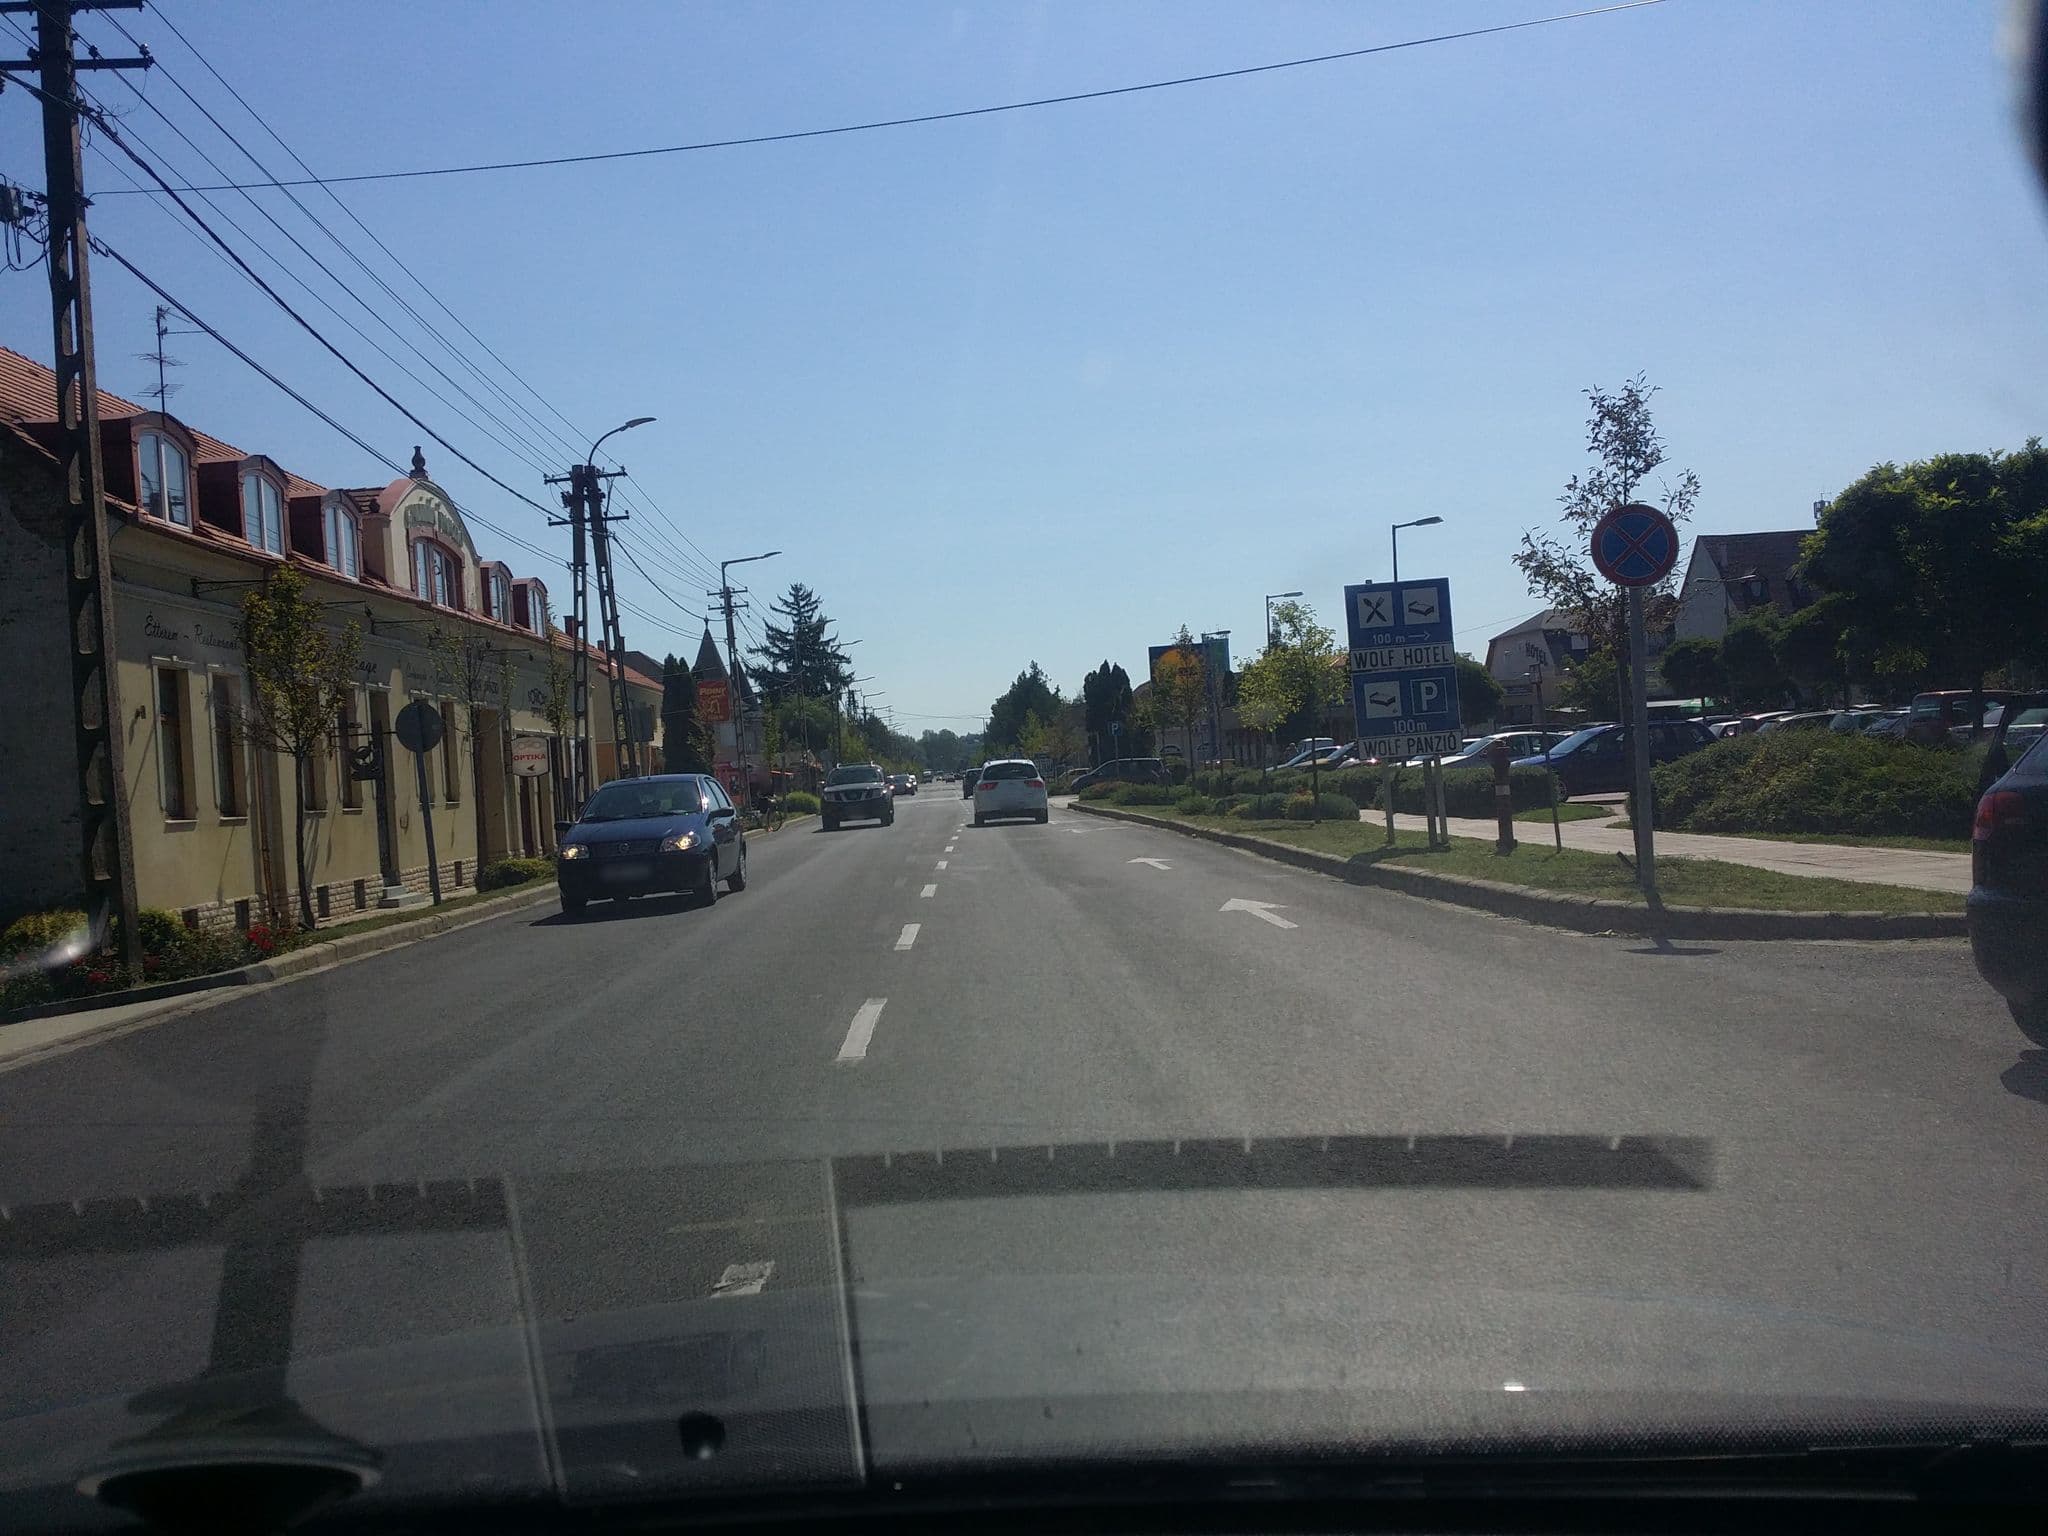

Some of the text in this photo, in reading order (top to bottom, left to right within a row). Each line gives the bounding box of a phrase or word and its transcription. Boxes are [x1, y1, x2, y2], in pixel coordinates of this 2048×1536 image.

[1373, 633, 1405, 645] 100 m
[1354, 645, 1450, 669] WOLF HOTEL
[1525, 640, 1548, 667] HOTEL
[1421, 681, 1438, 711] P
[513, 753, 546, 761] OPTIKA
[1363, 732, 1457, 758] WOLF PANZIÓ
